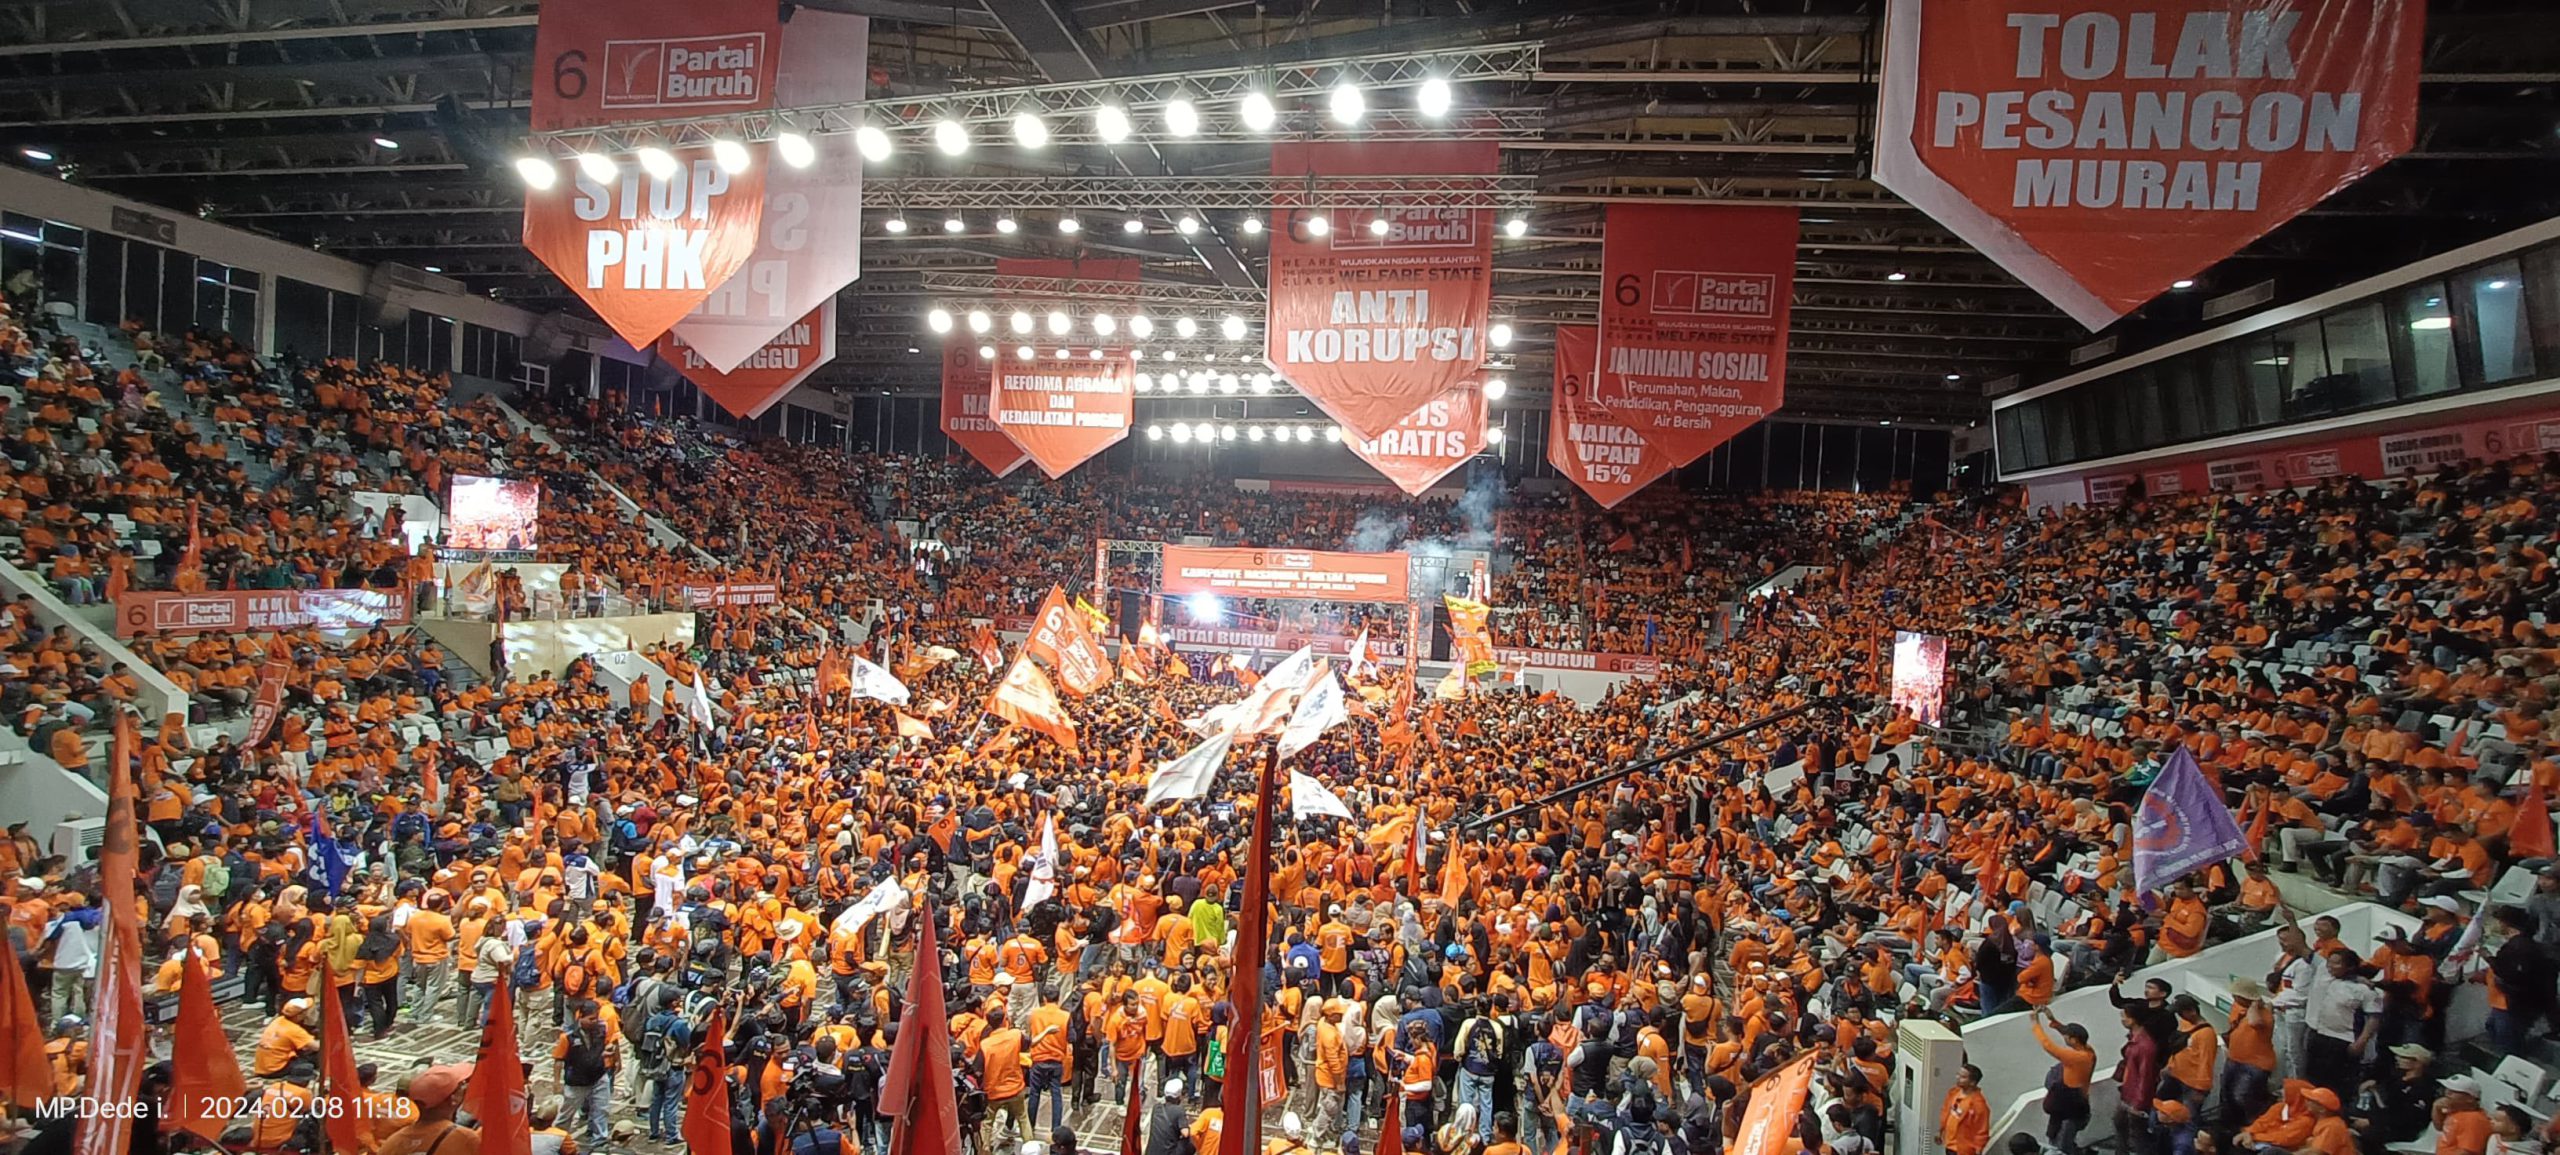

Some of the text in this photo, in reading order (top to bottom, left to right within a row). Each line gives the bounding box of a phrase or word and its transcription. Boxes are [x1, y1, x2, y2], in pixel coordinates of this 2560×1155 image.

[2007, 11, 2303, 81] TOLAK
[669, 43, 754, 73] Partai
[552, 49, 588, 98] 6
[667, 71, 753, 98] Buruh
[1934, 90, 2362, 152] PESANGON
[574, 159, 728, 221] STOP
[2012, 158, 2262, 211] MURAH
[1389, 221, 1467, 242] Buruh
[587, 230, 710, 290] PHK
[1340, 258, 1390, 266] WUJUDKAN
[1391, 257, 1427, 265] NEGARA
[1339, 267, 1483, 282] WELFARE STATE
[1615, 274, 1641, 307] 6
[1701, 278, 1768, 297] Partai
[1330, 289, 1429, 324] ANTI
[1700, 294, 1766, 312] Buruh
[1287, 326, 1474, 363] KORUPSI
[1656, 330, 1727, 344] WELFARE
[1608, 347, 1768, 382] JAMINAN SOSIAL
[1562, 374, 1579, 397] 6
[1628, 380, 1743, 401] Perumahan, Makan,
[1050, 394, 1074, 409] DAN
[1605, 395, 1672, 413] Pendidikan,
[1675, 400, 1765, 418] Pengangguran,
[1000, 410, 1073, 426] KEDAULATAN
[1654, 414, 1711, 430] Air Bersih
[1568, 422, 1649, 446] NAIKA
[2486, 431, 2502, 454] 6
[1579, 443, 1640, 465] UPAH
[1584, 465, 1631, 484] 15%
[1253, 552, 1263, 565] 6
[127, 604, 148, 626] 6
[1046, 606, 1065, 632] 6
[1217, 631, 1276, 647] BURUH
[1531, 651, 1595, 669] BURUH
